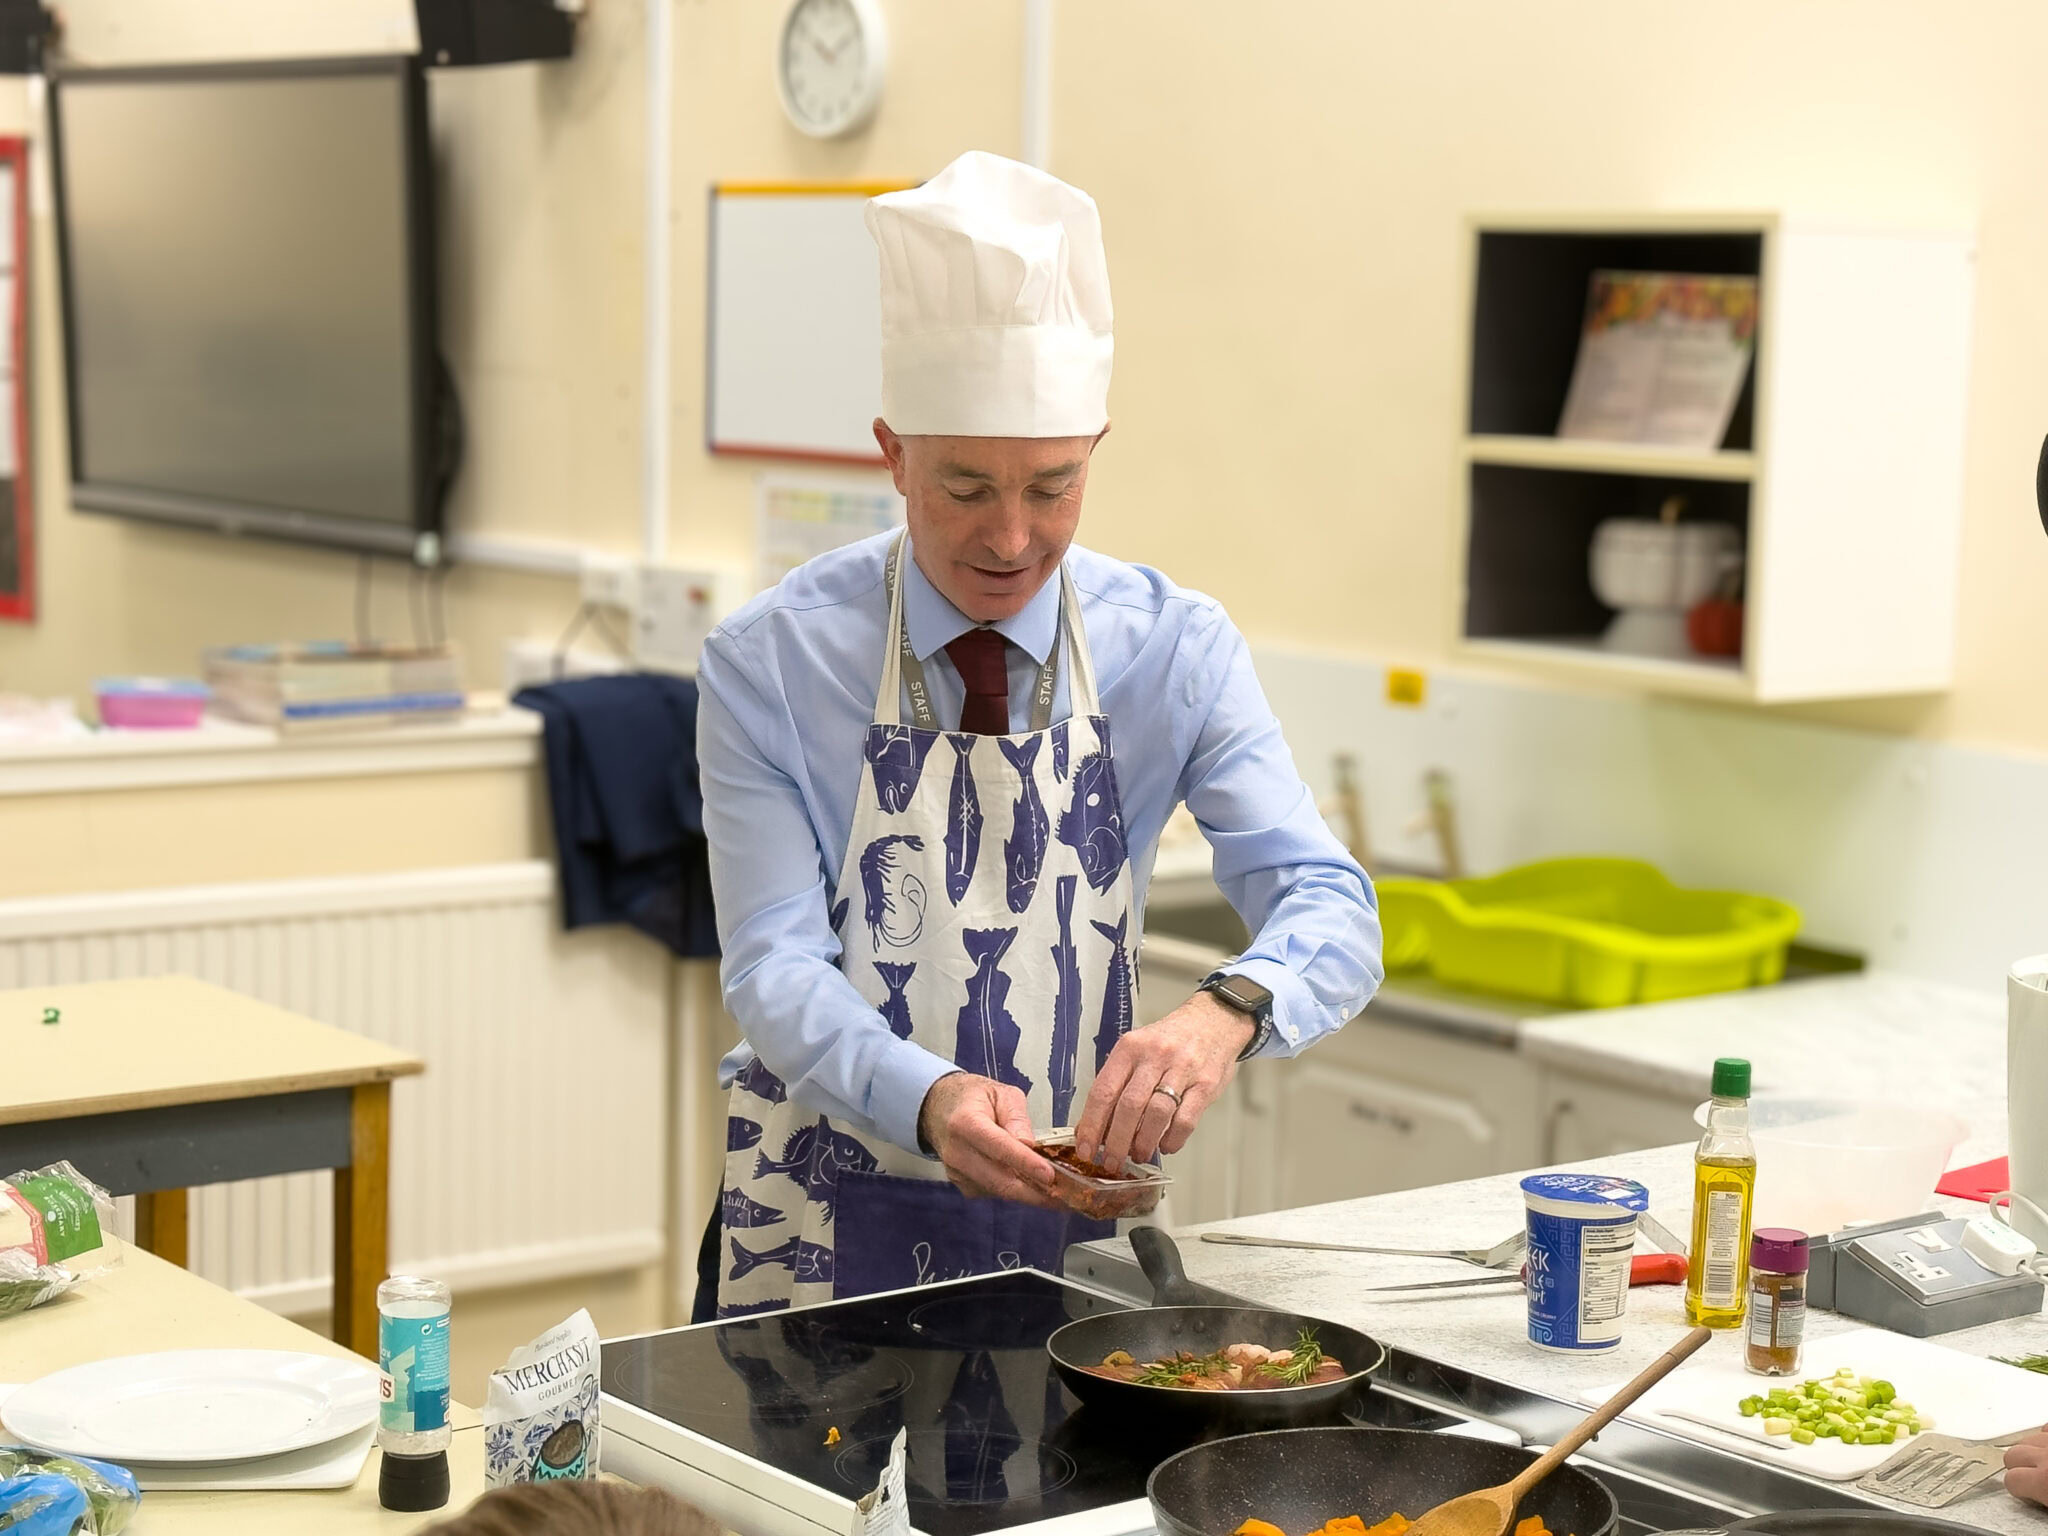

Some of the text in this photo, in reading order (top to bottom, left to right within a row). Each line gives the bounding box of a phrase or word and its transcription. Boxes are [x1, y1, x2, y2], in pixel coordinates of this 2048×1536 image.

[901, 617, 914, 657] TAFF
[911, 681, 931, 721] STAFF
[1039, 664, 1054, 706] STAFF
[503, 1336, 592, 1396] MERCHANT
[538, 1375, 578, 1402] GOURMET
